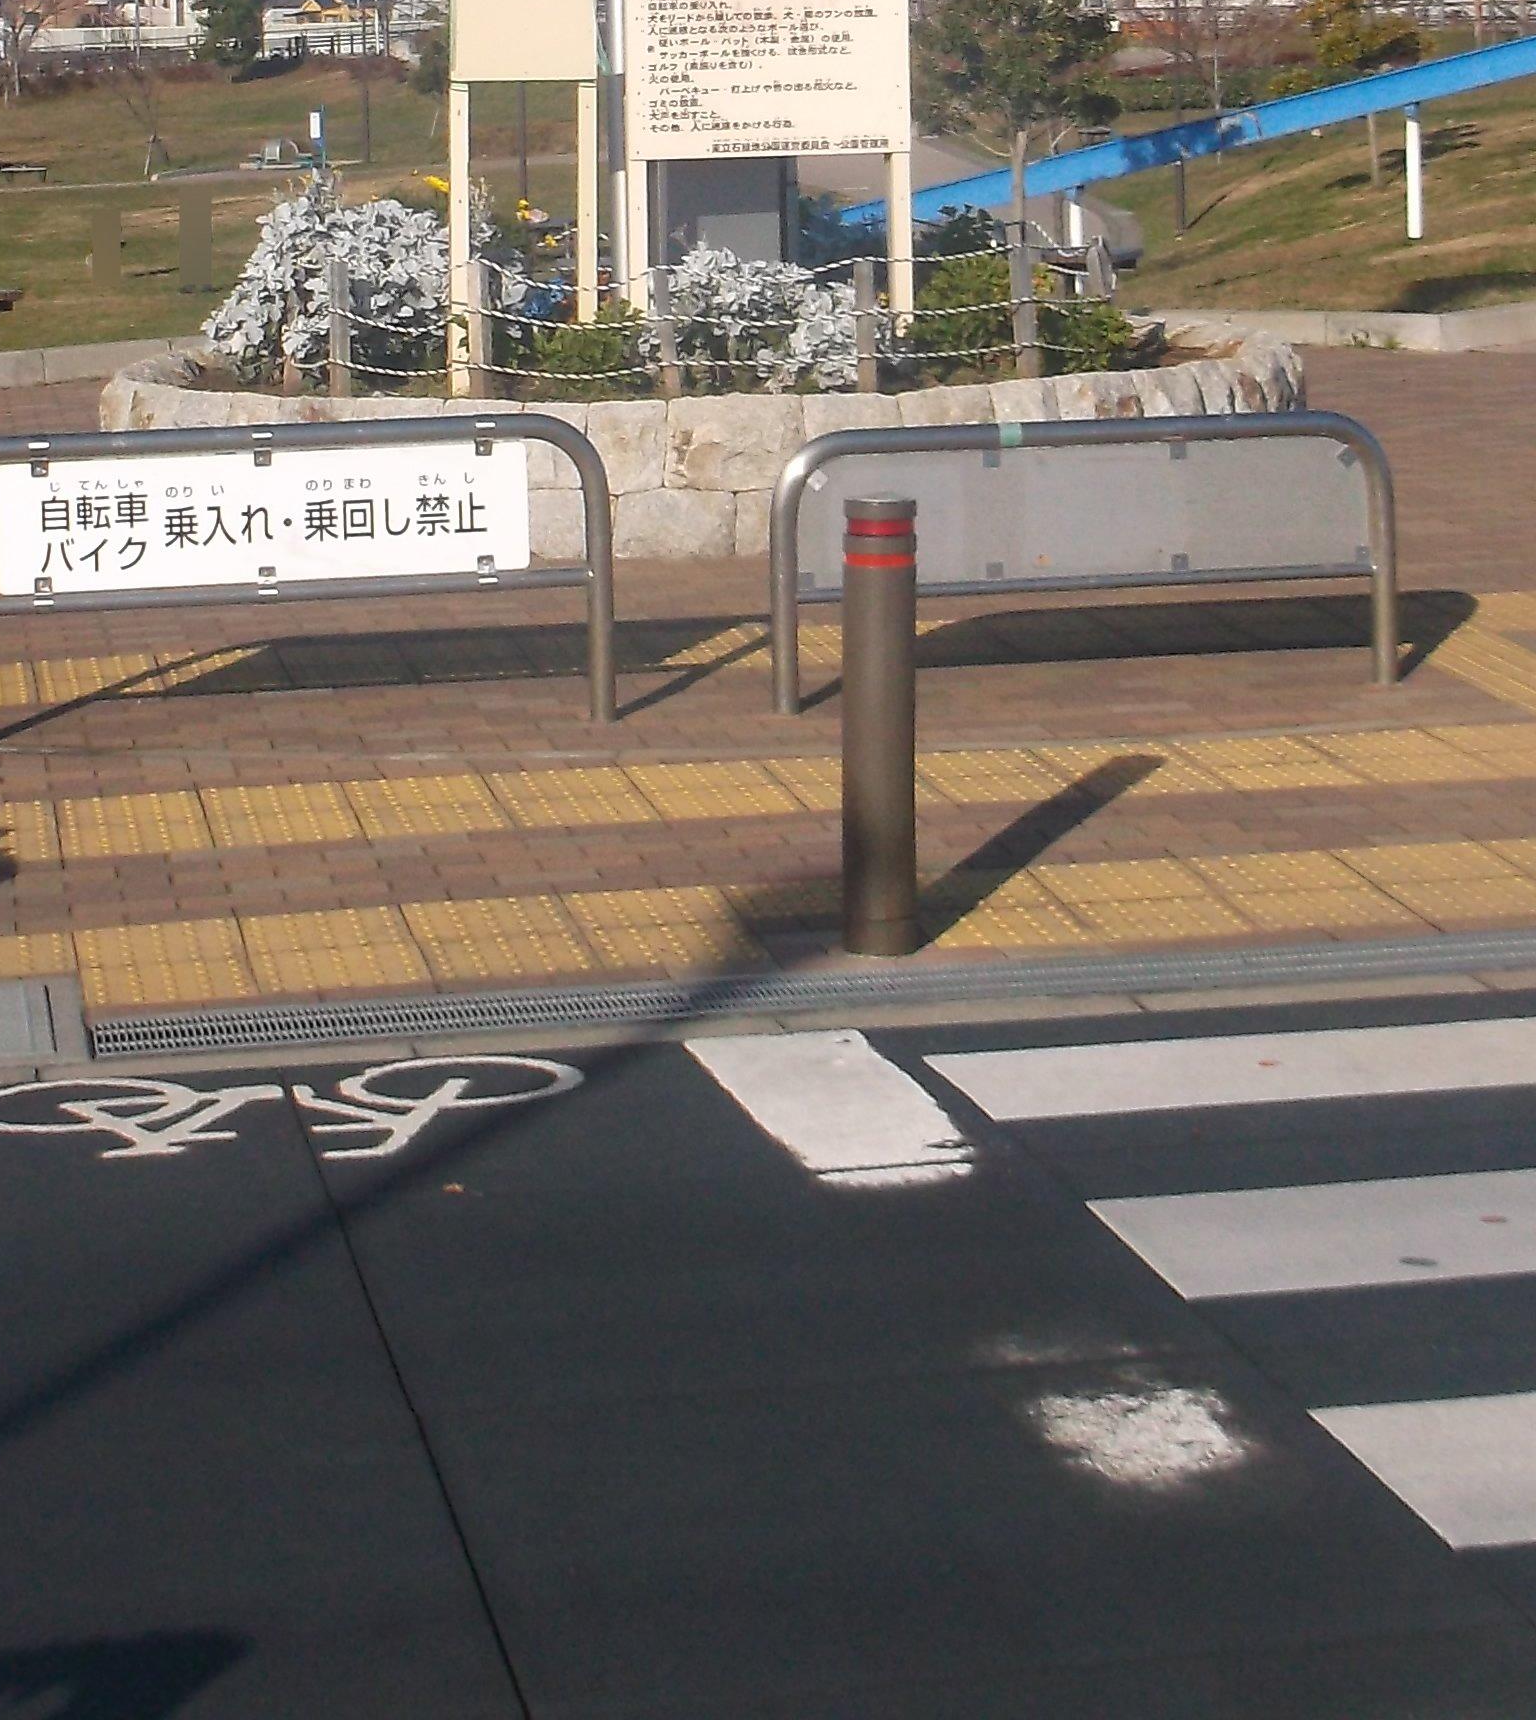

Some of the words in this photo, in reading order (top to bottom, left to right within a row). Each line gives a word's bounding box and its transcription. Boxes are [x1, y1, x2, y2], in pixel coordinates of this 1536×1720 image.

[40, 492, 150, 533] 自転車
[40, 535, 148, 574] バイク
